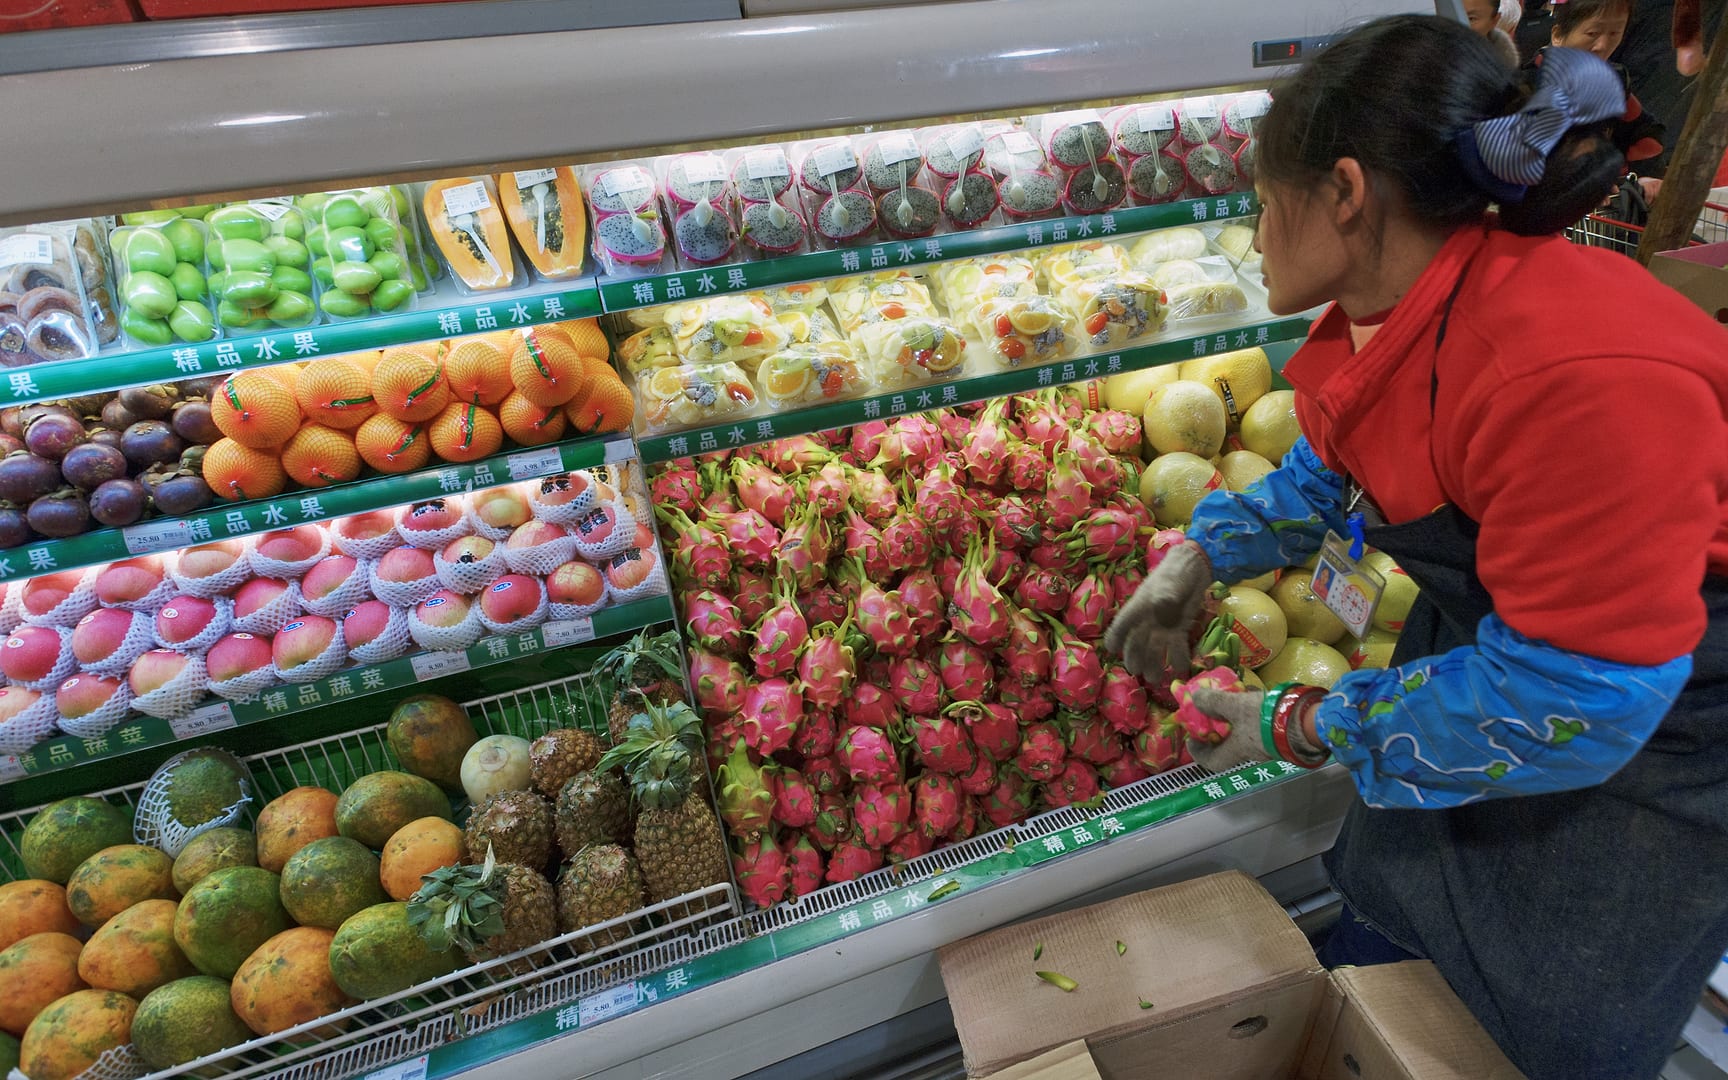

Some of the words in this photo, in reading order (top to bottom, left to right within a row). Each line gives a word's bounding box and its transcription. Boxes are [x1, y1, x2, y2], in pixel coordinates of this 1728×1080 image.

[1026, 214, 1118, 245] 精品水果
[840, 240, 944, 272] 精品水果
[632, 268, 748, 304] 精品水果
[437, 297, 566, 335] 精品水果
[172, 331, 320, 373] 精品水果
[1192, 327, 1270, 356] 精品水果
[7, 371, 40, 398] 果
[1037, 354, 1123, 386] 精品水果
[863, 385, 958, 419] 精品水果
[667, 421, 776, 456] 精品水果
[437, 464, 513, 492] 精品
[186, 496, 326, 541] 精品水果
[137, 534, 160, 545] 25.80
[262, 667, 385, 714] 精品蔬菜
[1042, 816, 1126, 854] 精品果
